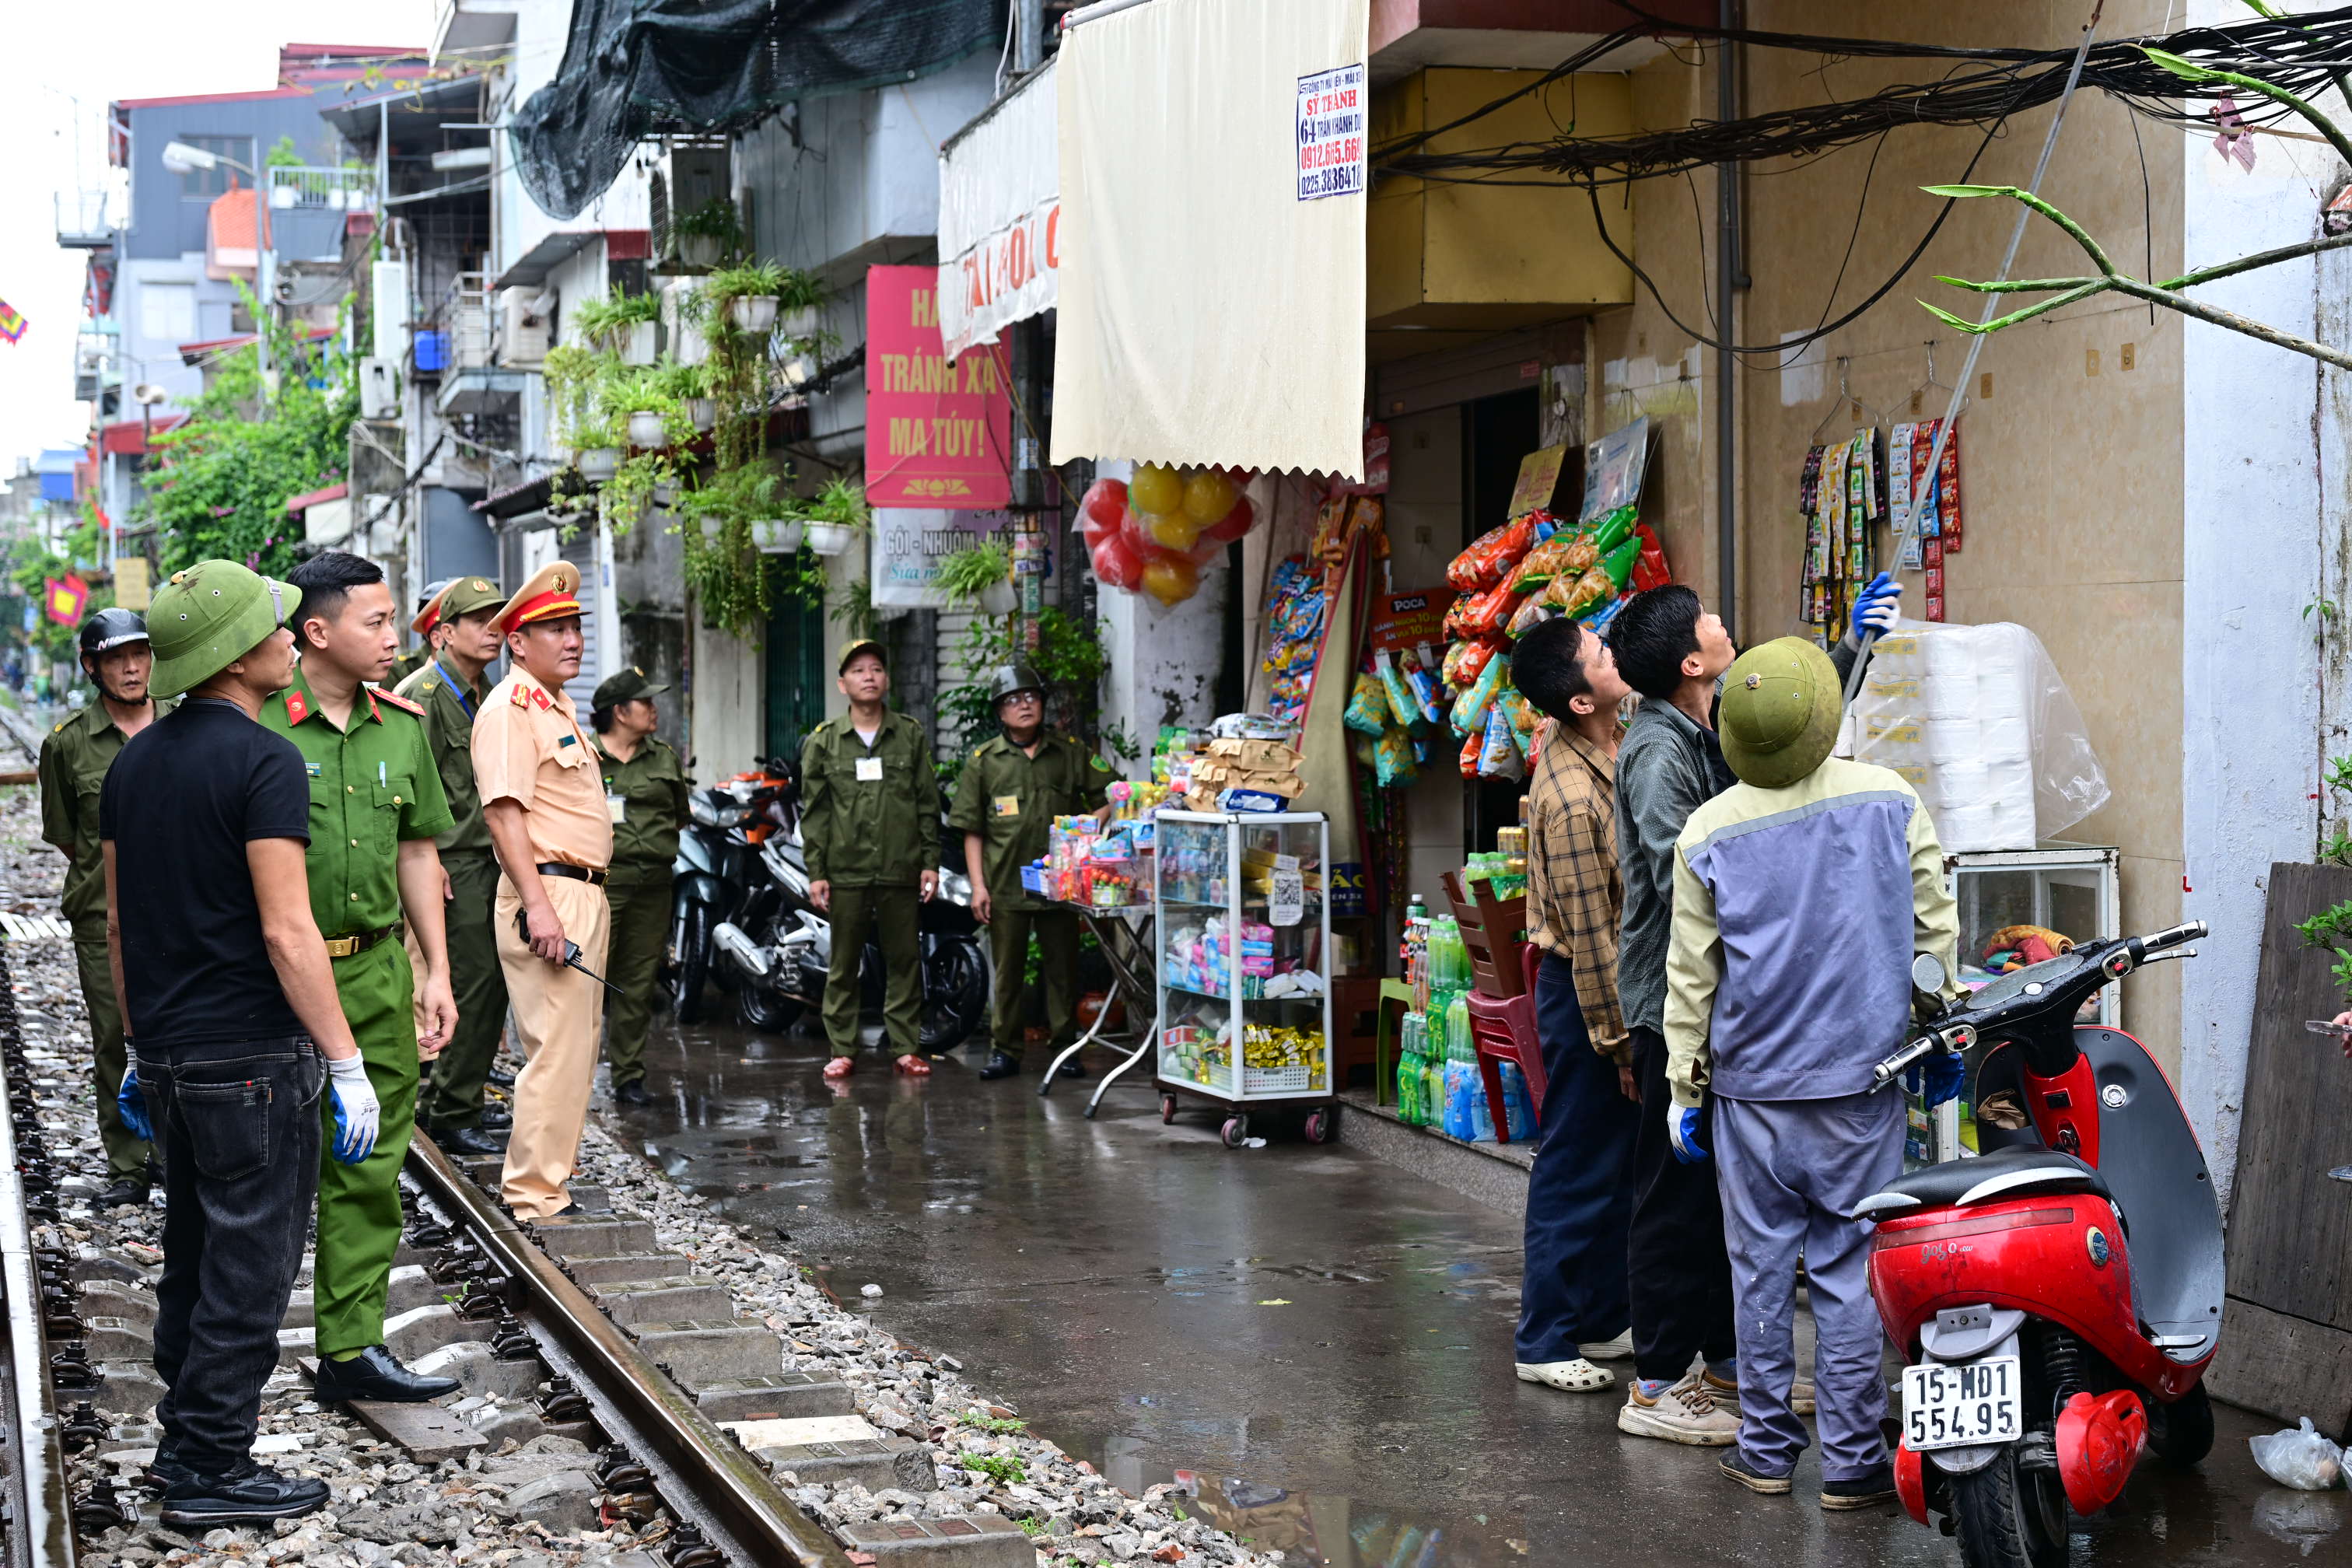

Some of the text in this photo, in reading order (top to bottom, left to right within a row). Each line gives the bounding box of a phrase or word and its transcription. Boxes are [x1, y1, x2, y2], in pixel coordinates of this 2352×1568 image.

[1300, 117, 1316, 145] 64
[880, 346, 996, 394] TRÁNH XA
[889, 418, 927, 457] MA
[932, 410, 985, 457] TÚY!
[884, 524, 910, 560] GỘI
[1394, 598, 1426, 612] POCA
[1419, 612, 1430, 623] 10
[1411, 625, 1423, 635] 10
[1911, 1401, 2013, 1443] 554.95
